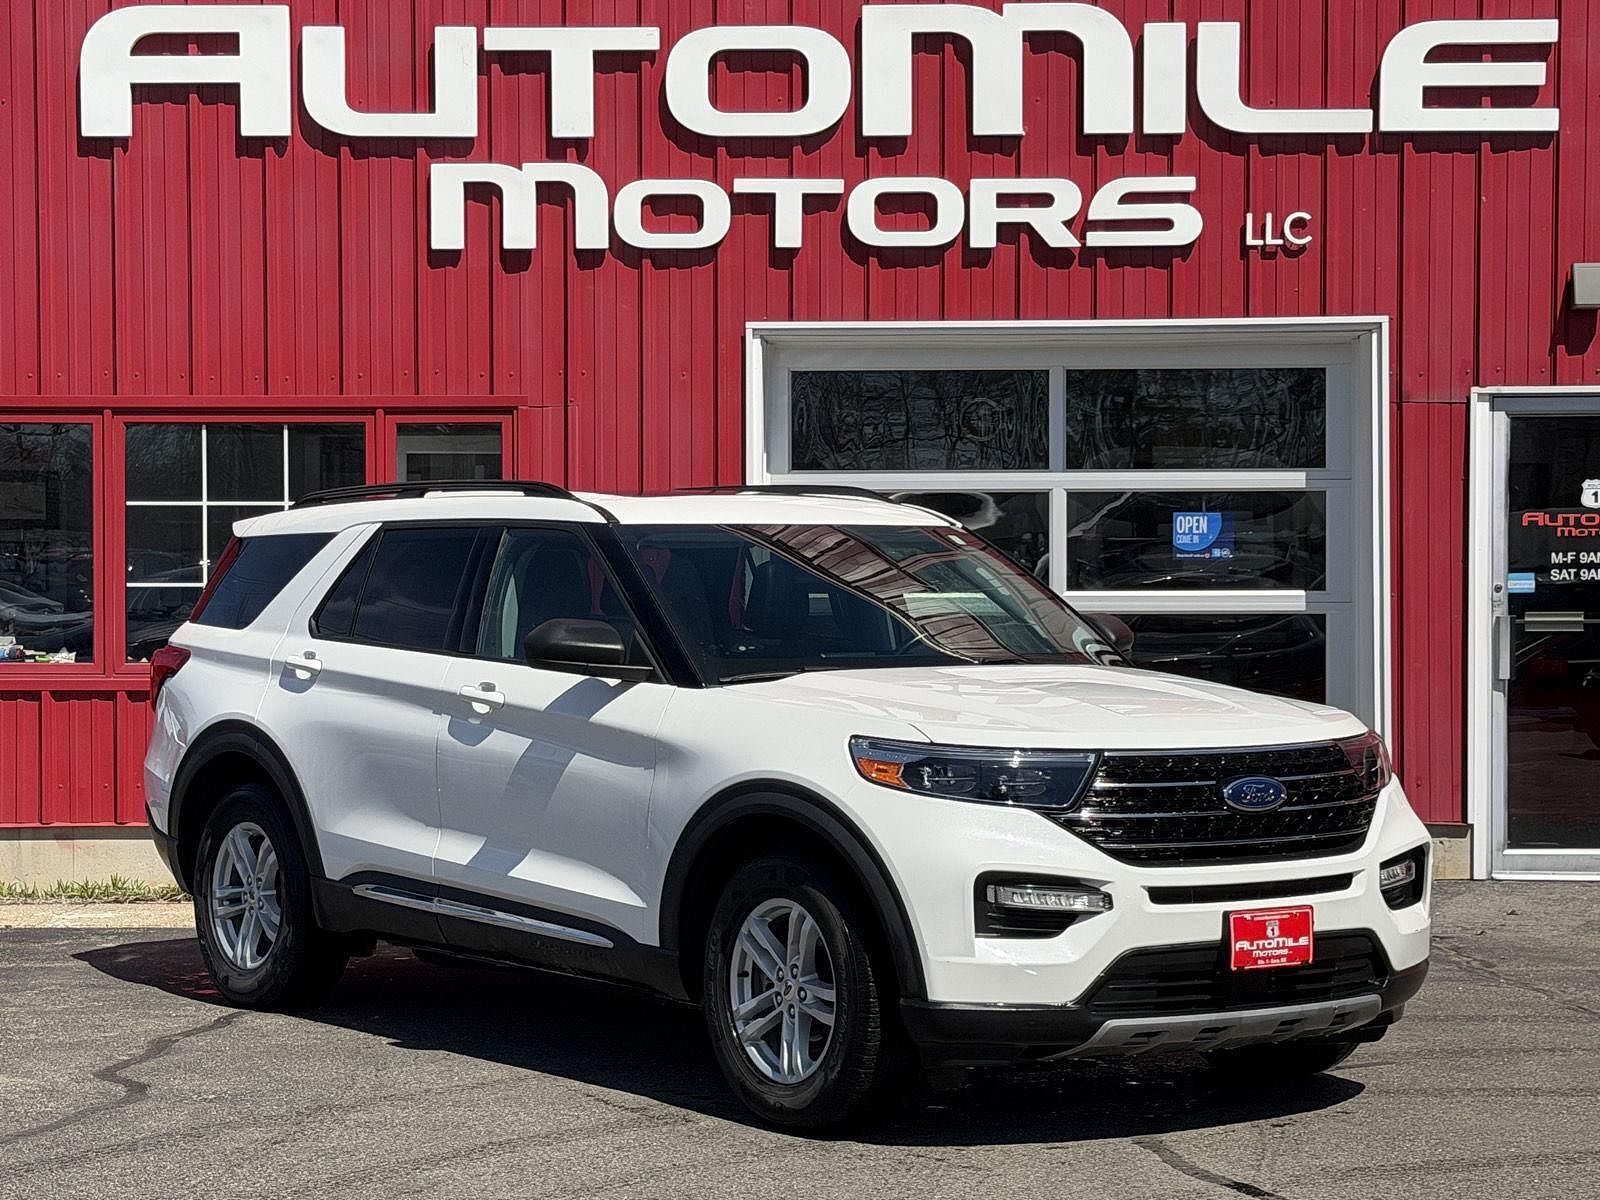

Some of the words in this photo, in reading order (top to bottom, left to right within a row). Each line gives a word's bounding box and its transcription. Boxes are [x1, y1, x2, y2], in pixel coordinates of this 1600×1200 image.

[79, 2, 1561, 138] AUTOMILE
[430, 162, 1204, 250] MOTORS
[1246, 211, 1313, 246] LLC
[1176, 515, 1208, 534] OPEN
[1176, 534, 1193, 544] COME
[1556, 527, 1600, 537] MOT
[1550, 552, 1577, 564] M-F
[1550, 568, 1577, 581] SAT
[1579, 568, 1600, 581] 9A
[1241, 784, 1275, 803] Ford
[1235, 936, 1309, 952] AUTOMILE
[1252, 948, 1289, 958] MOTORS
